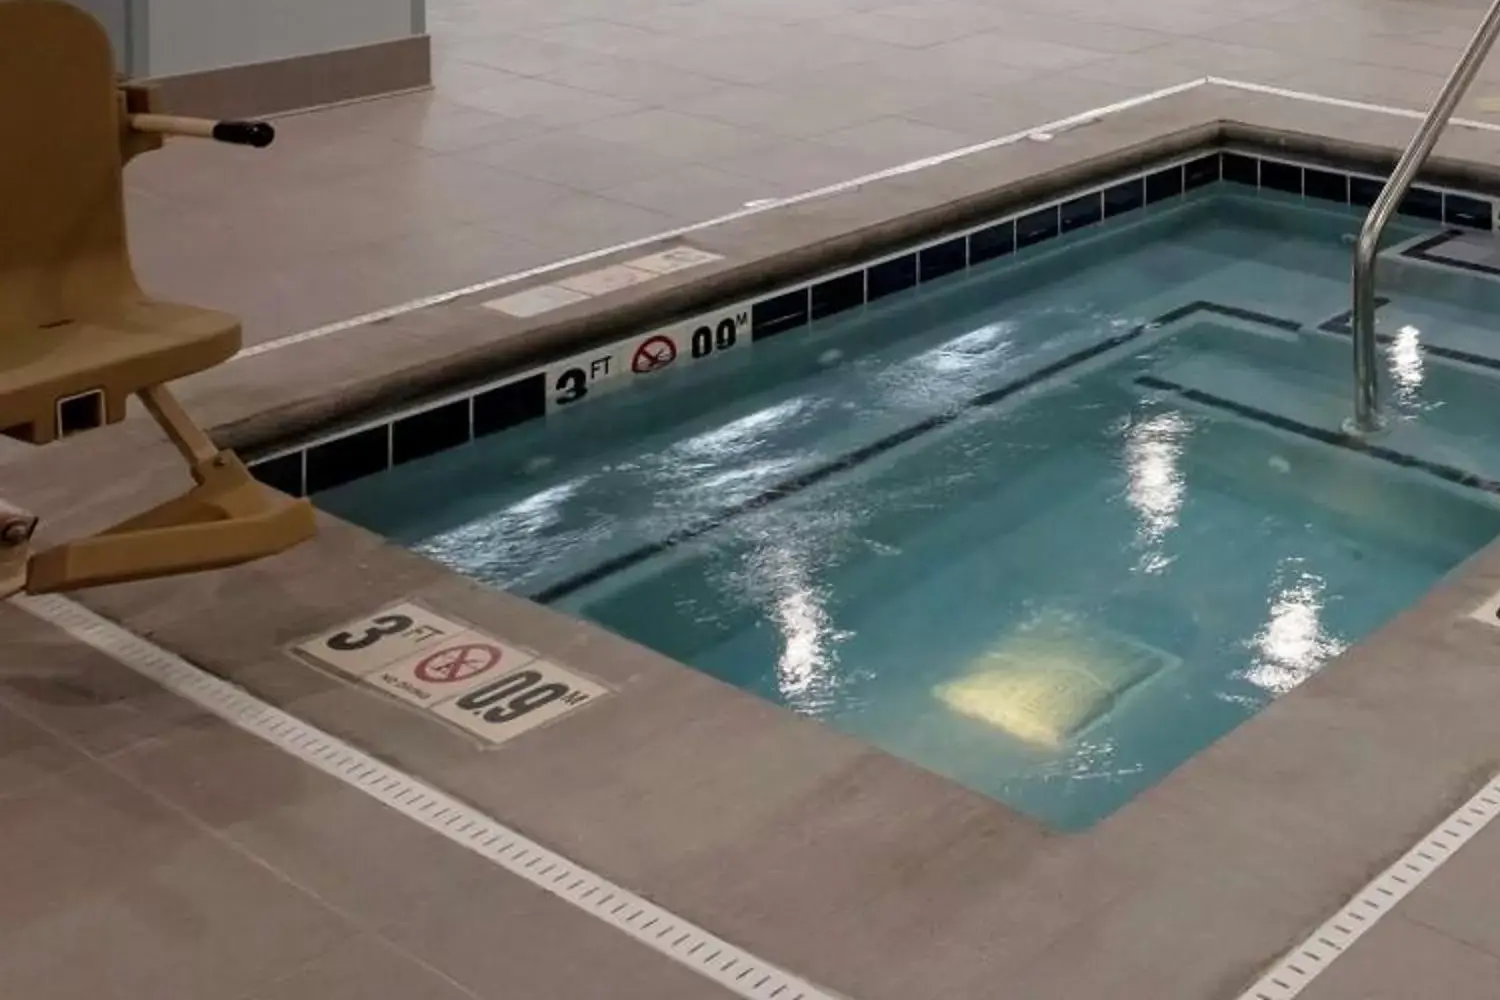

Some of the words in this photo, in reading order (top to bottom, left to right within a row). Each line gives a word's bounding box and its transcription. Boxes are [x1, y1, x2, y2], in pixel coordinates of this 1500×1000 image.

[556, 368, 588, 405] 3
[591, 355, 612, 379] FT
[326, 615, 414, 650] 3
[401, 625, 446, 643] FT
